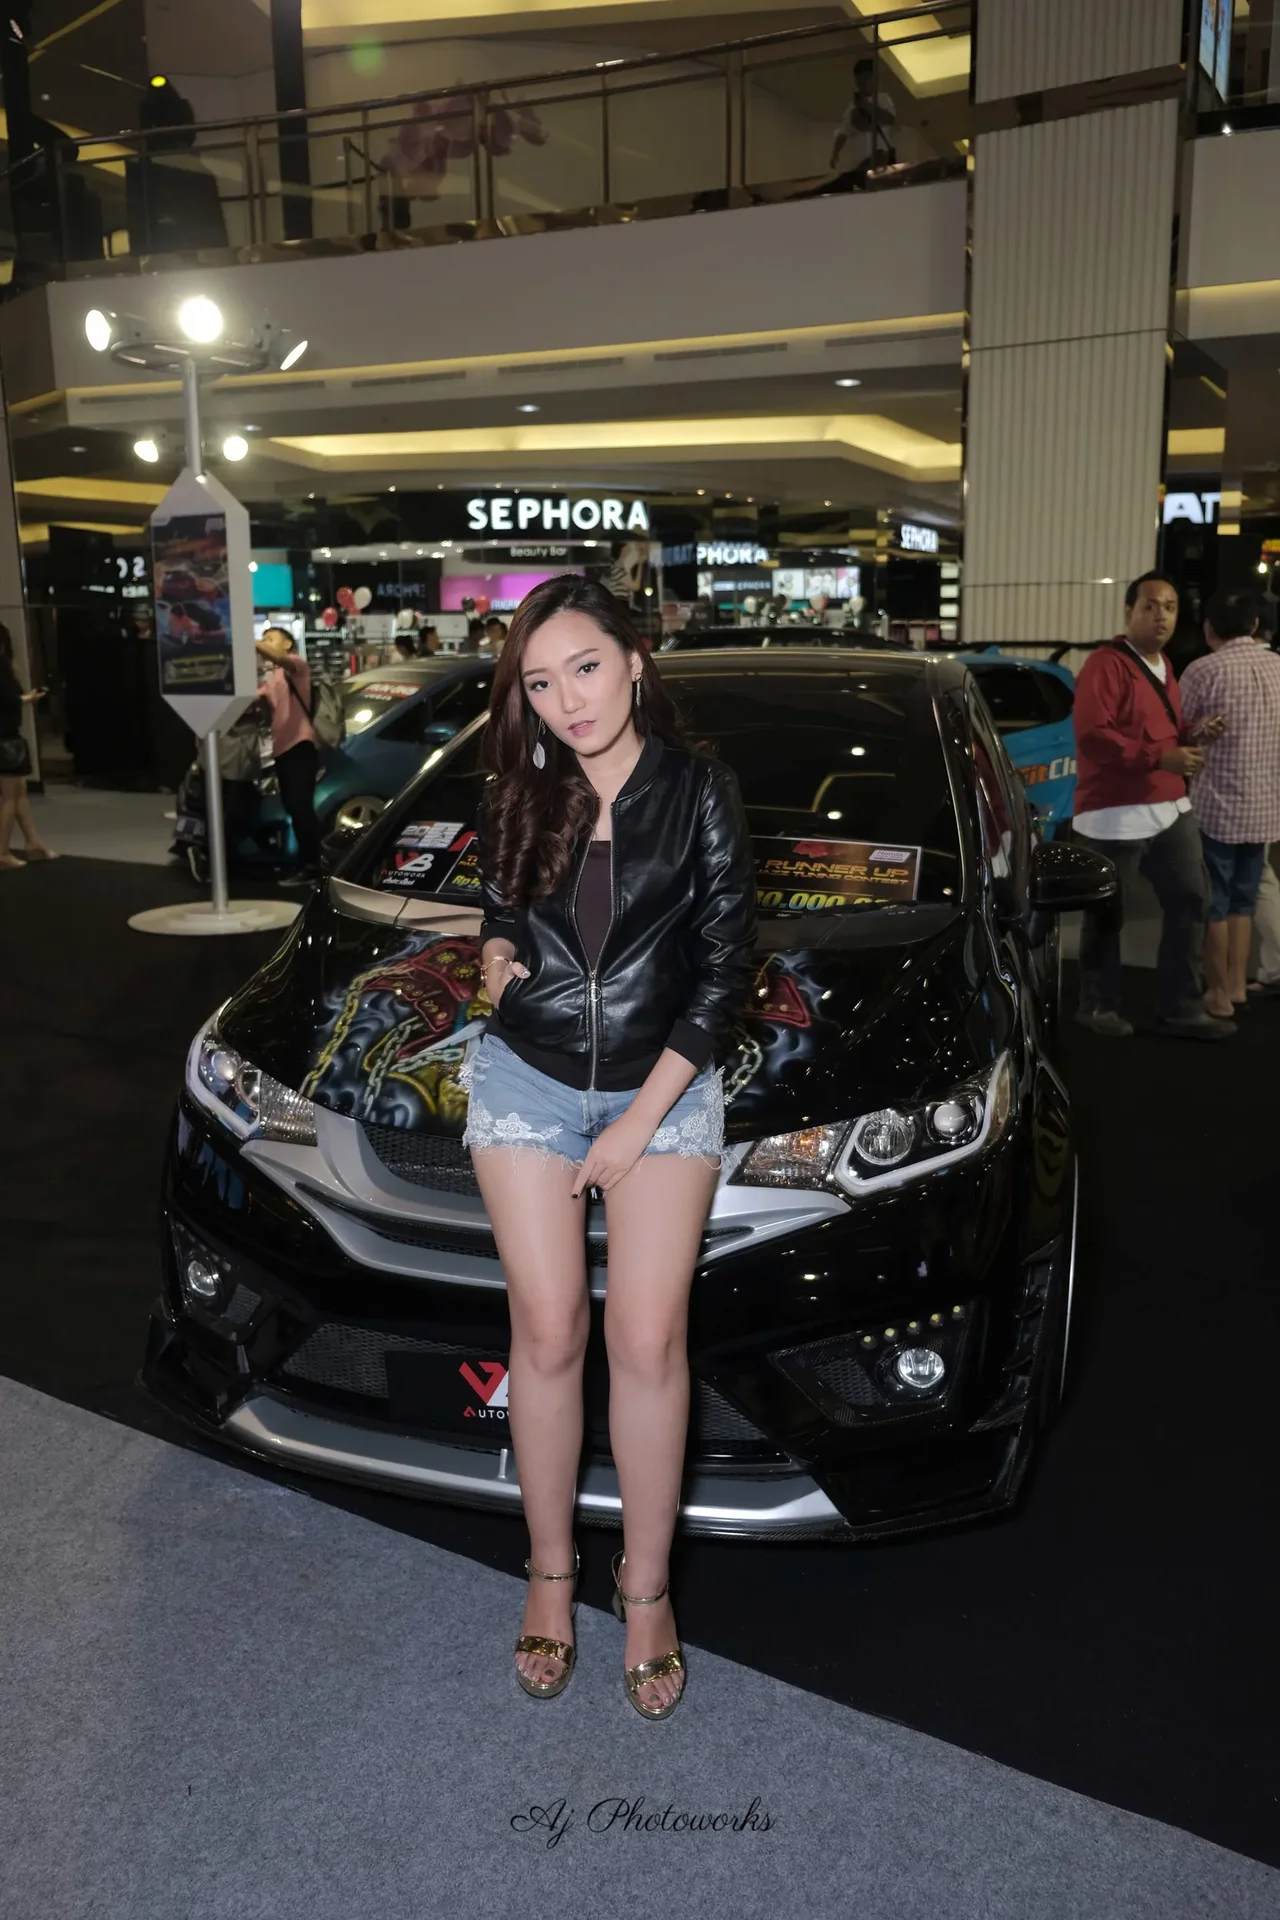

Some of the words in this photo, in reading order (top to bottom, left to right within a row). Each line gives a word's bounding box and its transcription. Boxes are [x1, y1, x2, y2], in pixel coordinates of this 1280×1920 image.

[467, 498, 649, 530] SEPHORA
[510, 547, 548, 557] Beauty
[550, 546, 567, 556] Bar
[765, 859, 868, 875] RUNNER
[874, 866, 909, 878] UP
[793, 870, 841, 880] TUNING
[844, 875, 909, 885] CONTEST
